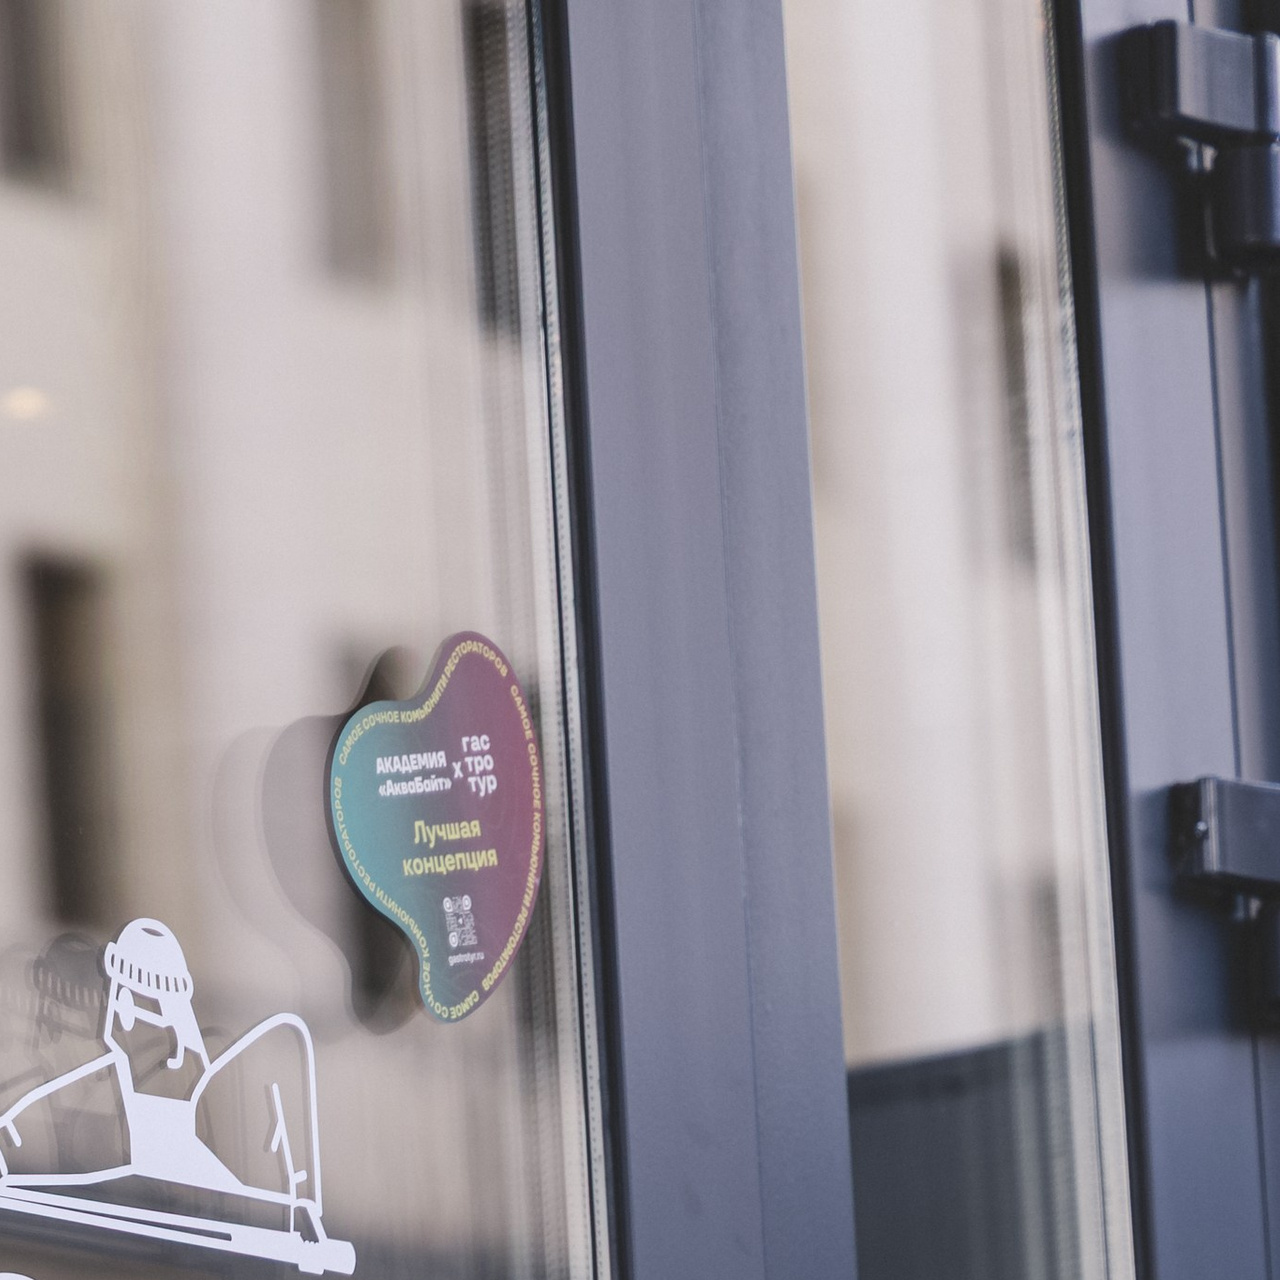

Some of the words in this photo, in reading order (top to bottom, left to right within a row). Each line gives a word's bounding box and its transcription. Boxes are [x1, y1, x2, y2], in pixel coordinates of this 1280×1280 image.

[339, 724, 363, 765] САМОЕ
[362, 710, 400, 731] СОЧНОЕ
[400, 675, 449, 724] КОМЬЮНИТИ
[444, 640, 509, 678] РЕСТОРАТОРОВ
[510, 685, 533, 740] САМОЕ
[376, 751, 447, 774] АКАДЕМИЯ
[462, 734, 491, 752] гас
[465, 754, 494, 774] тро
[378, 775, 452, 797] «АкваБайт»
[468, 774, 497, 797] тур
[528, 743, 541, 809] СОЧНОЕ
[334, 777, 375, 893] РЕСТОРАТОРОВ
[414, 820, 481, 848] Лучшая
[402, 849, 498, 876] концепция
[523, 812, 541, 909] КОМЬЮНИТИ
[376, 887, 430, 958] КОМЬЮНИТИ
[482, 908, 529, 991] РЕСТОРАТОРОВ
[423, 961, 448, 1018] СОЧНОЕ
[450, 990, 480, 1019] САМОЕ
